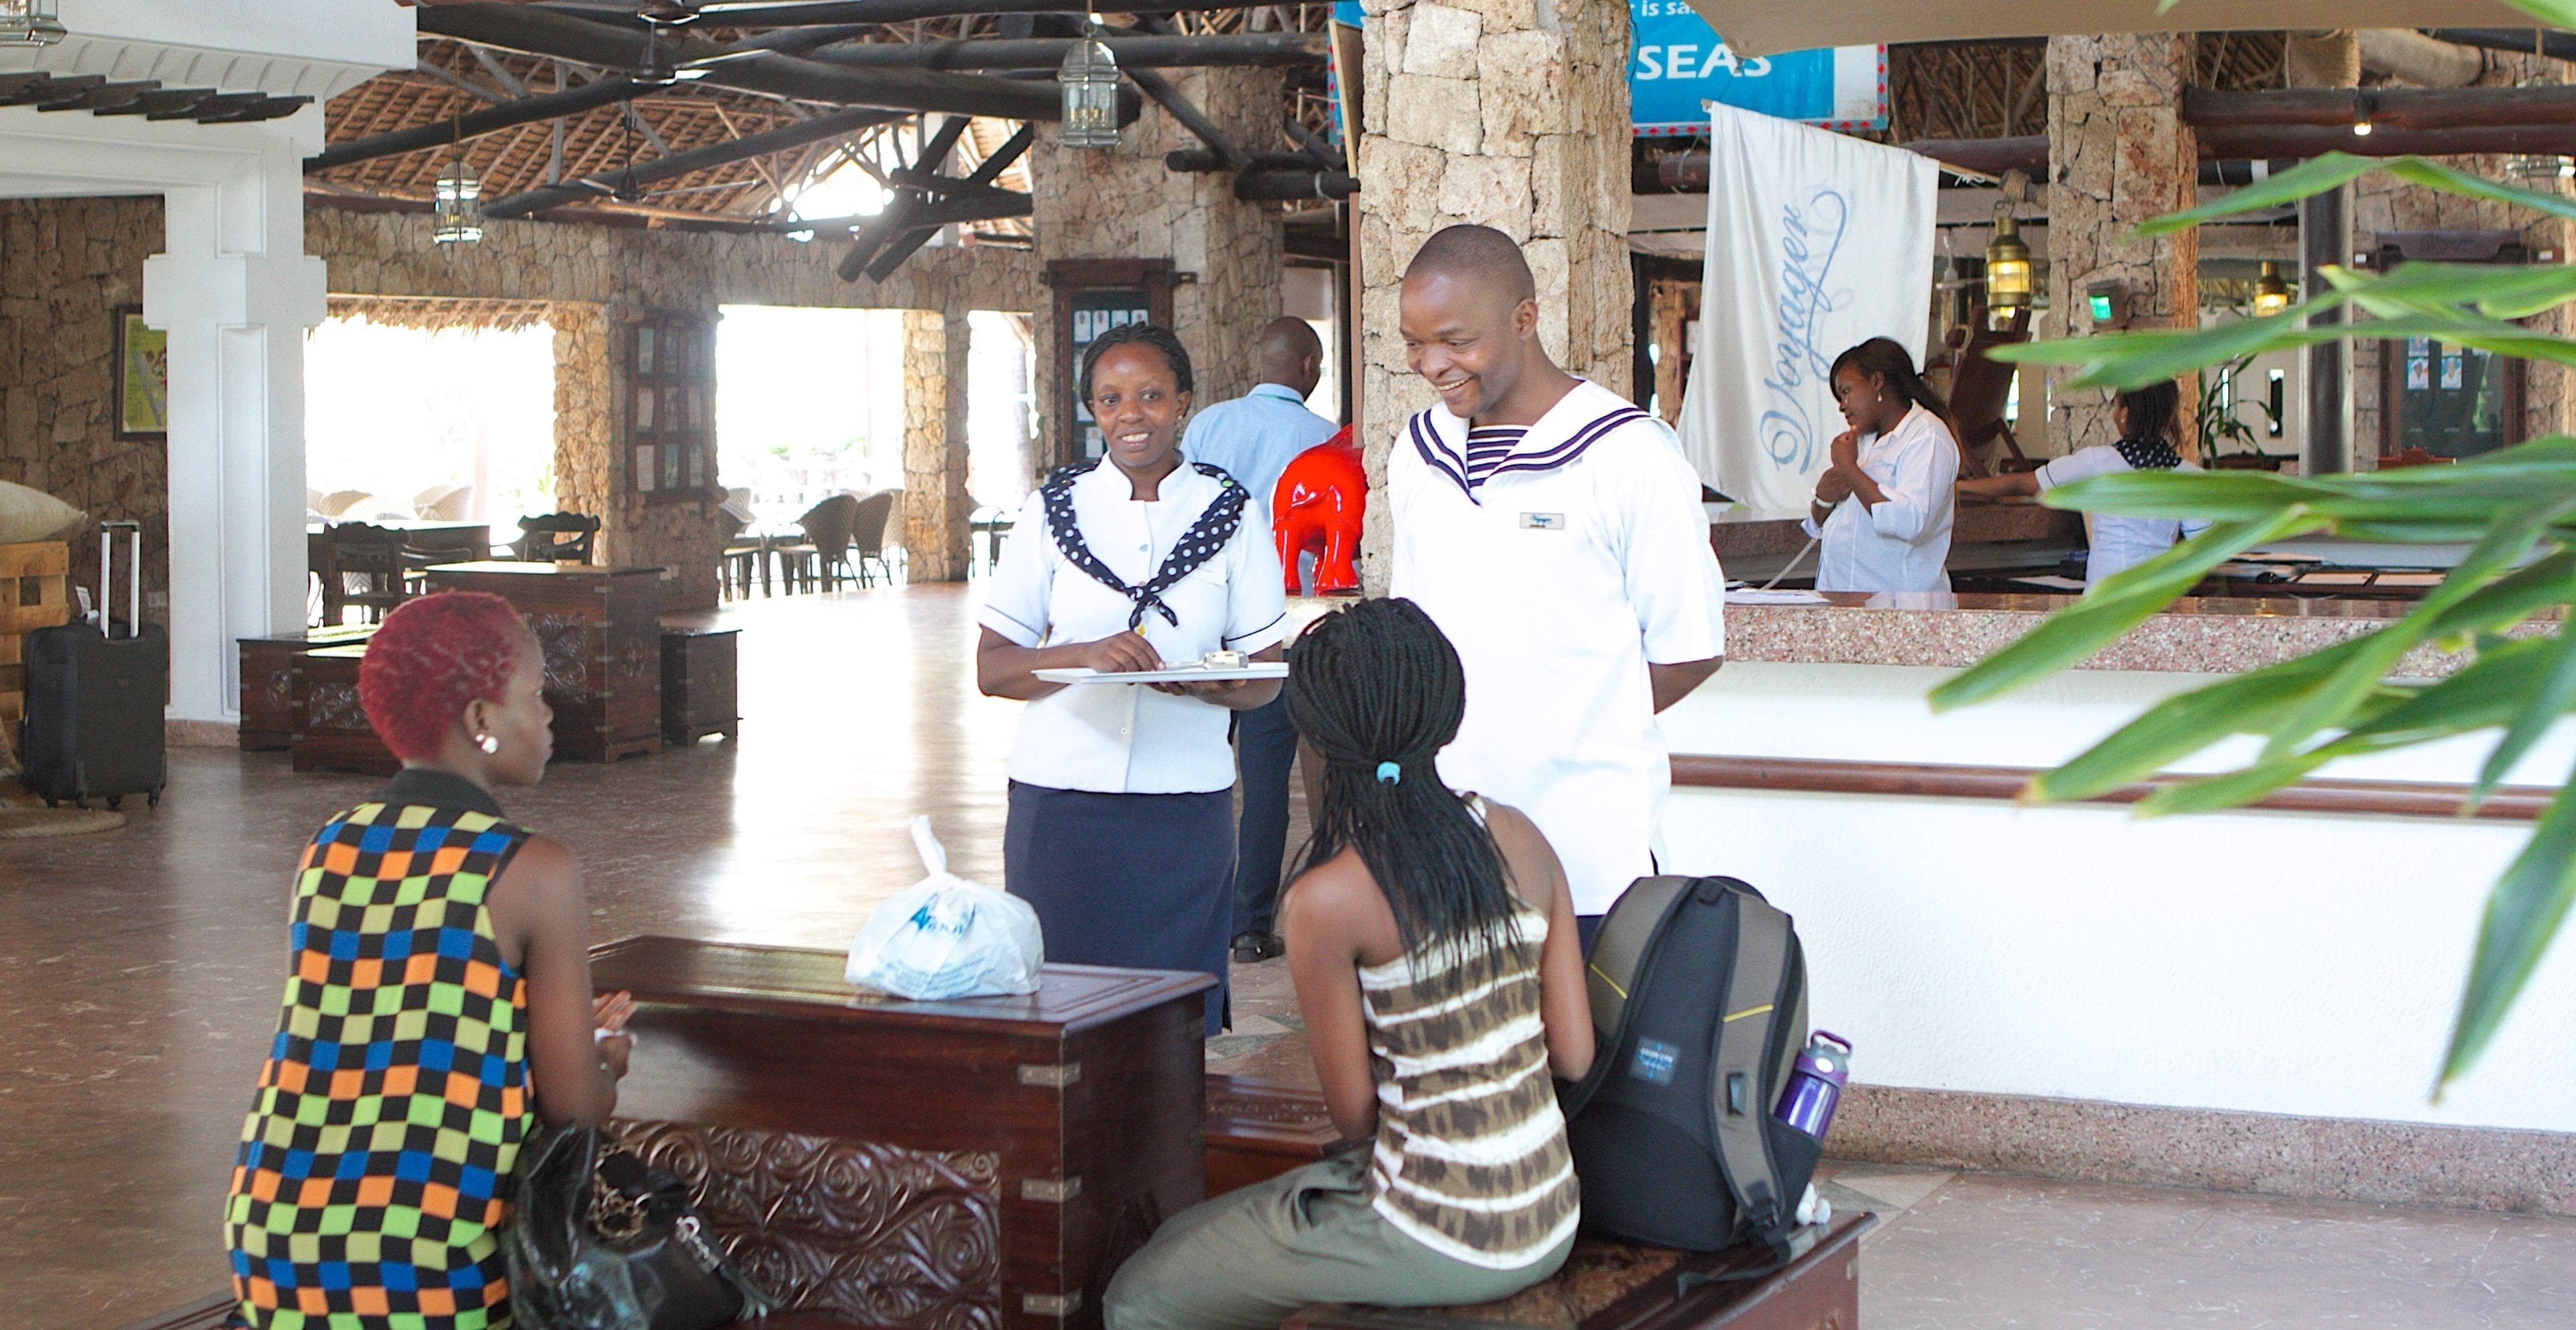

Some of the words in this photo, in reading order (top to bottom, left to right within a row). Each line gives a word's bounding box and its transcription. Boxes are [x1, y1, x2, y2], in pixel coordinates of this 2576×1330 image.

[1642, 0, 1659, 17] is
[1666, 1, 1697, 15] sa
[1635, 43, 1772, 80] SEAS
[1759, 190, 1847, 475] Voyager
